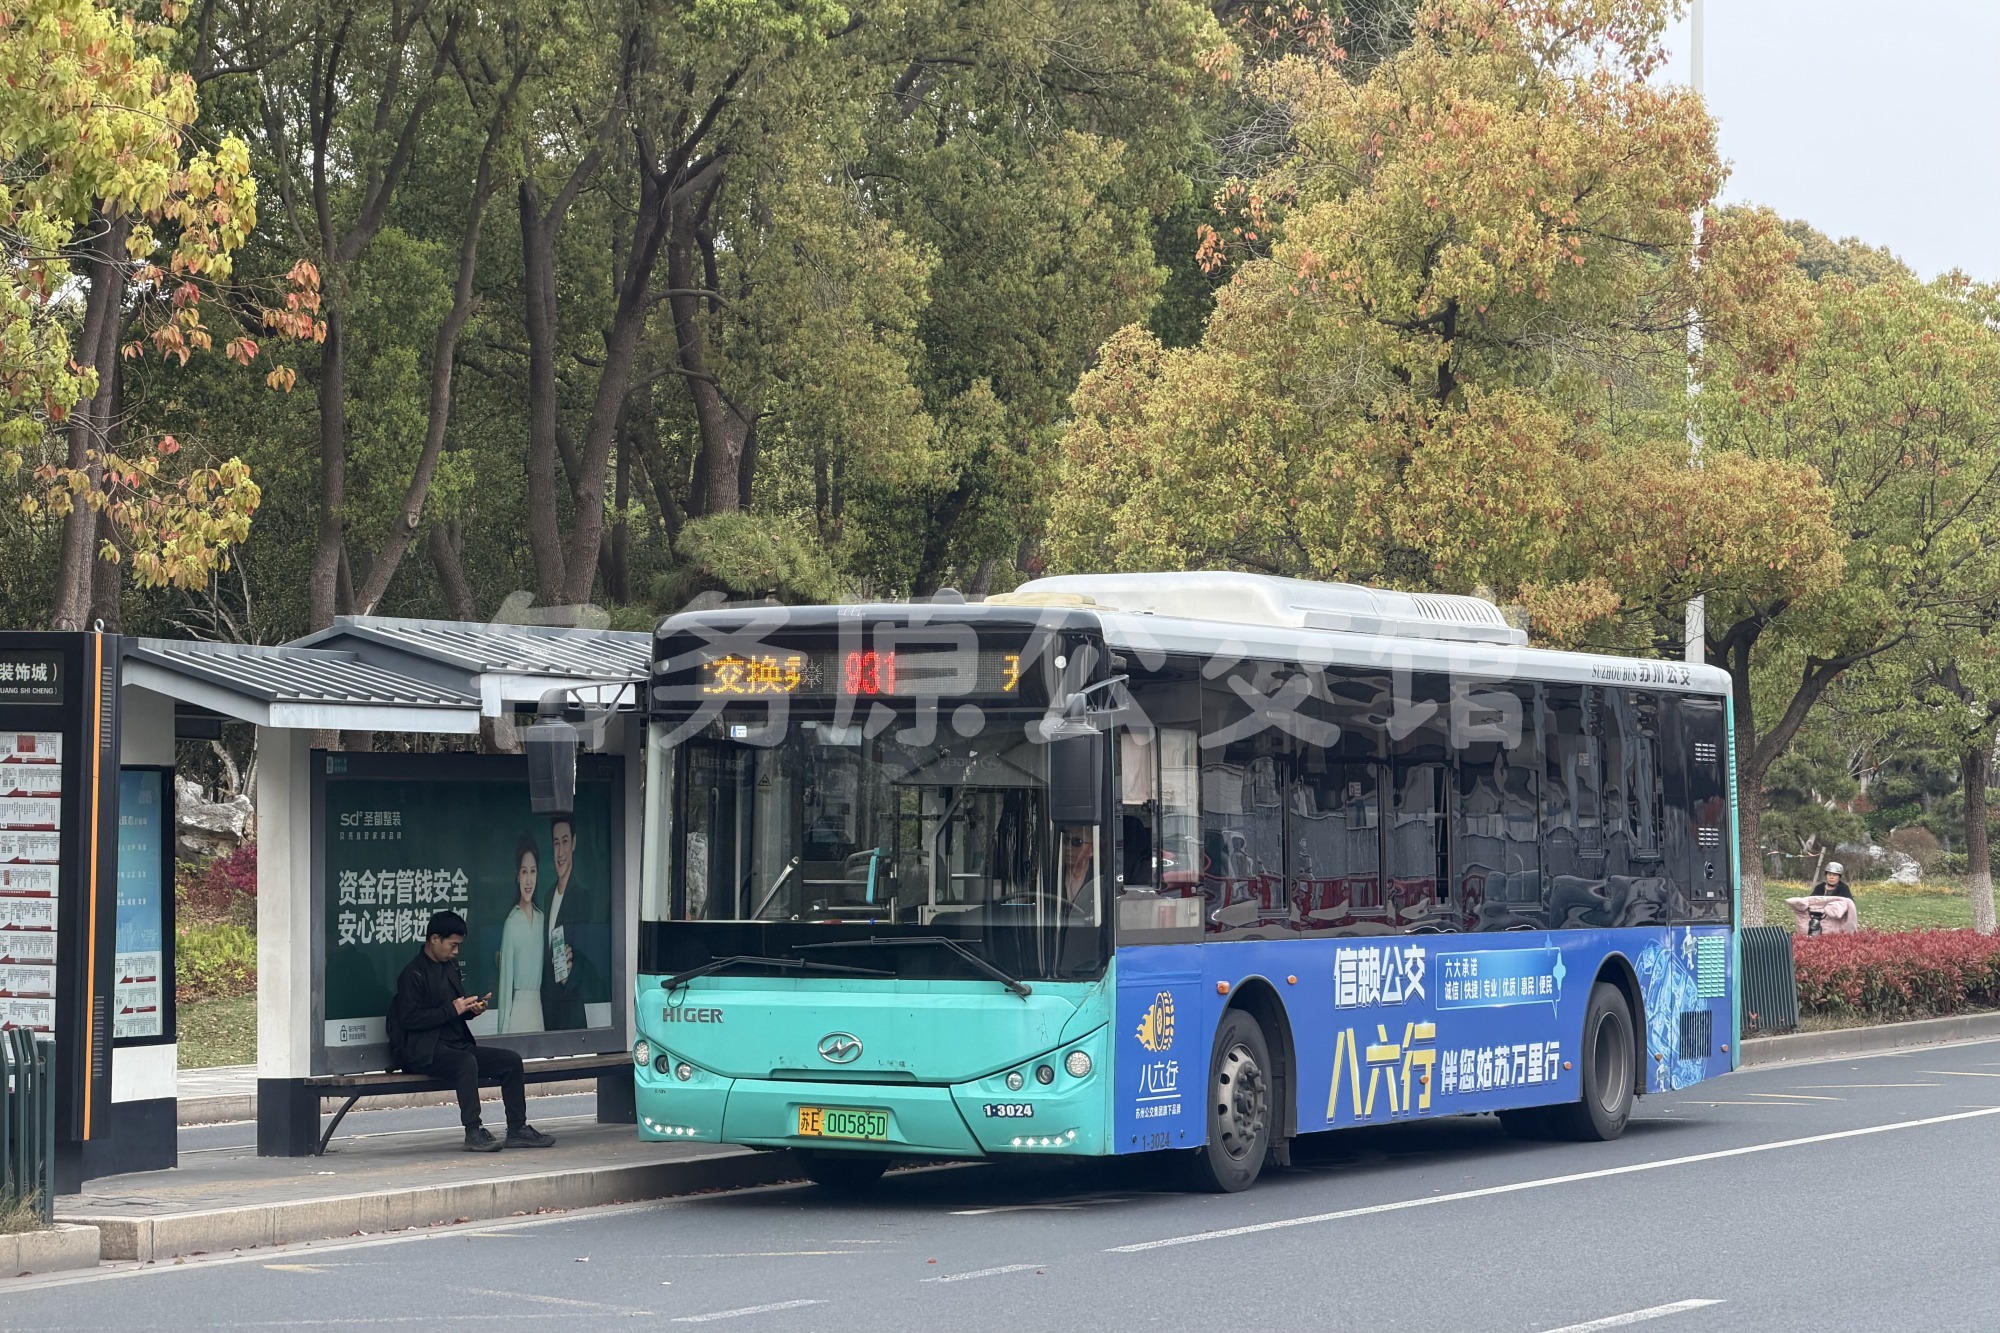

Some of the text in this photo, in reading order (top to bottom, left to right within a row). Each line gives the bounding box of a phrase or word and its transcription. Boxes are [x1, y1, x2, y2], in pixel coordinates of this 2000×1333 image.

[845, 651, 896, 694] 931
[1592, 664, 1637, 682] SUZHOU BUS
[338, 867, 469, 906] 资金存管钱安全
[338, 907, 468, 946] 安心装修选
[1333, 944, 1426, 1009] 信赖公交
[1445, 957, 1478, 979] 六大承诺
[1445, 975, 1553, 1001] 诚信 快捷 专业 优质 惠民 便民
[662, 1007, 724, 1023] HIGER
[1138, 1060, 1179, 1094] 八六行
[1326, 1022, 1437, 1123] 八六行
[1440, 1041, 1560, 1095] 伴您姑苏万里行
[1142, 1131, 1170, 1151] 1-3024
